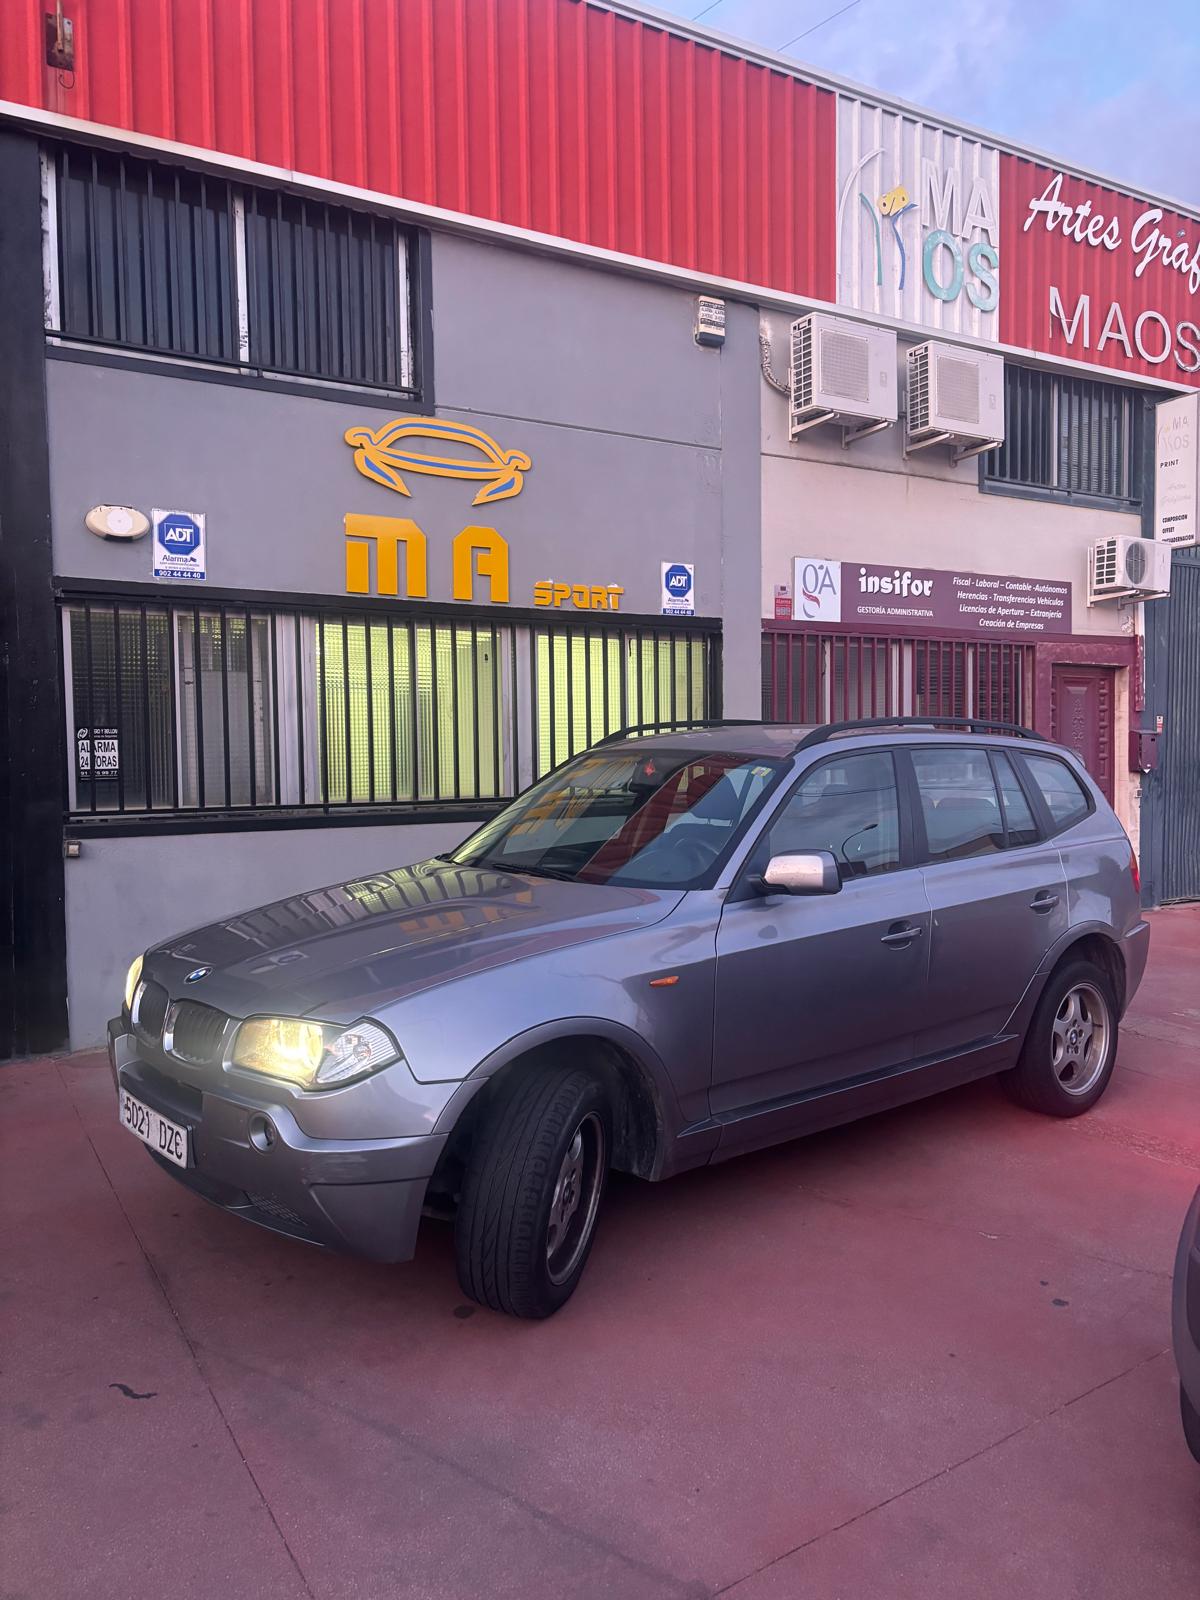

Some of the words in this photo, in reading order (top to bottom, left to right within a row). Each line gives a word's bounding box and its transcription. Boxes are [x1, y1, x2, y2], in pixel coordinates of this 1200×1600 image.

[922, 157, 998, 249] MA
[1024, 173, 1121, 250] Artes
[923, 230, 999, 312] OS
[1050, 286, 1200, 373] MAOS
[1160, 459, 1179, 468] PRINT
[165, 527, 194, 542] ADT
[162, 554, 188, 563] Alarma
[344, 513, 509, 603] MA
[534, 580, 625, 611] SPORT
[670, 575, 688, 587] ADT
[859, 567, 934, 597] insifor
[952, 577, 971, 586] Fiscal
[976, 579, 999, 589] Laboral
[1005, 581, 1032, 591] Contable
[957, 591, 988, 601] Herencias
[993, 593, 1036, 605] Transferencias
[887, 607, 934, 617] ADMINISTRATIVA
[959, 603, 987, 614] Licencias
[988, 606, 996, 614] de
[997, 606, 1024, 616] Apertura
[978, 618, 1006, 627] Creación
[1006, 619, 1015, 628] de
[1015, 620, 1044, 630] Empresas
[80, 755, 89, 767] 24
[95, 755, 117, 767] ORAS
[125, 1096, 149, 1139] 5021
